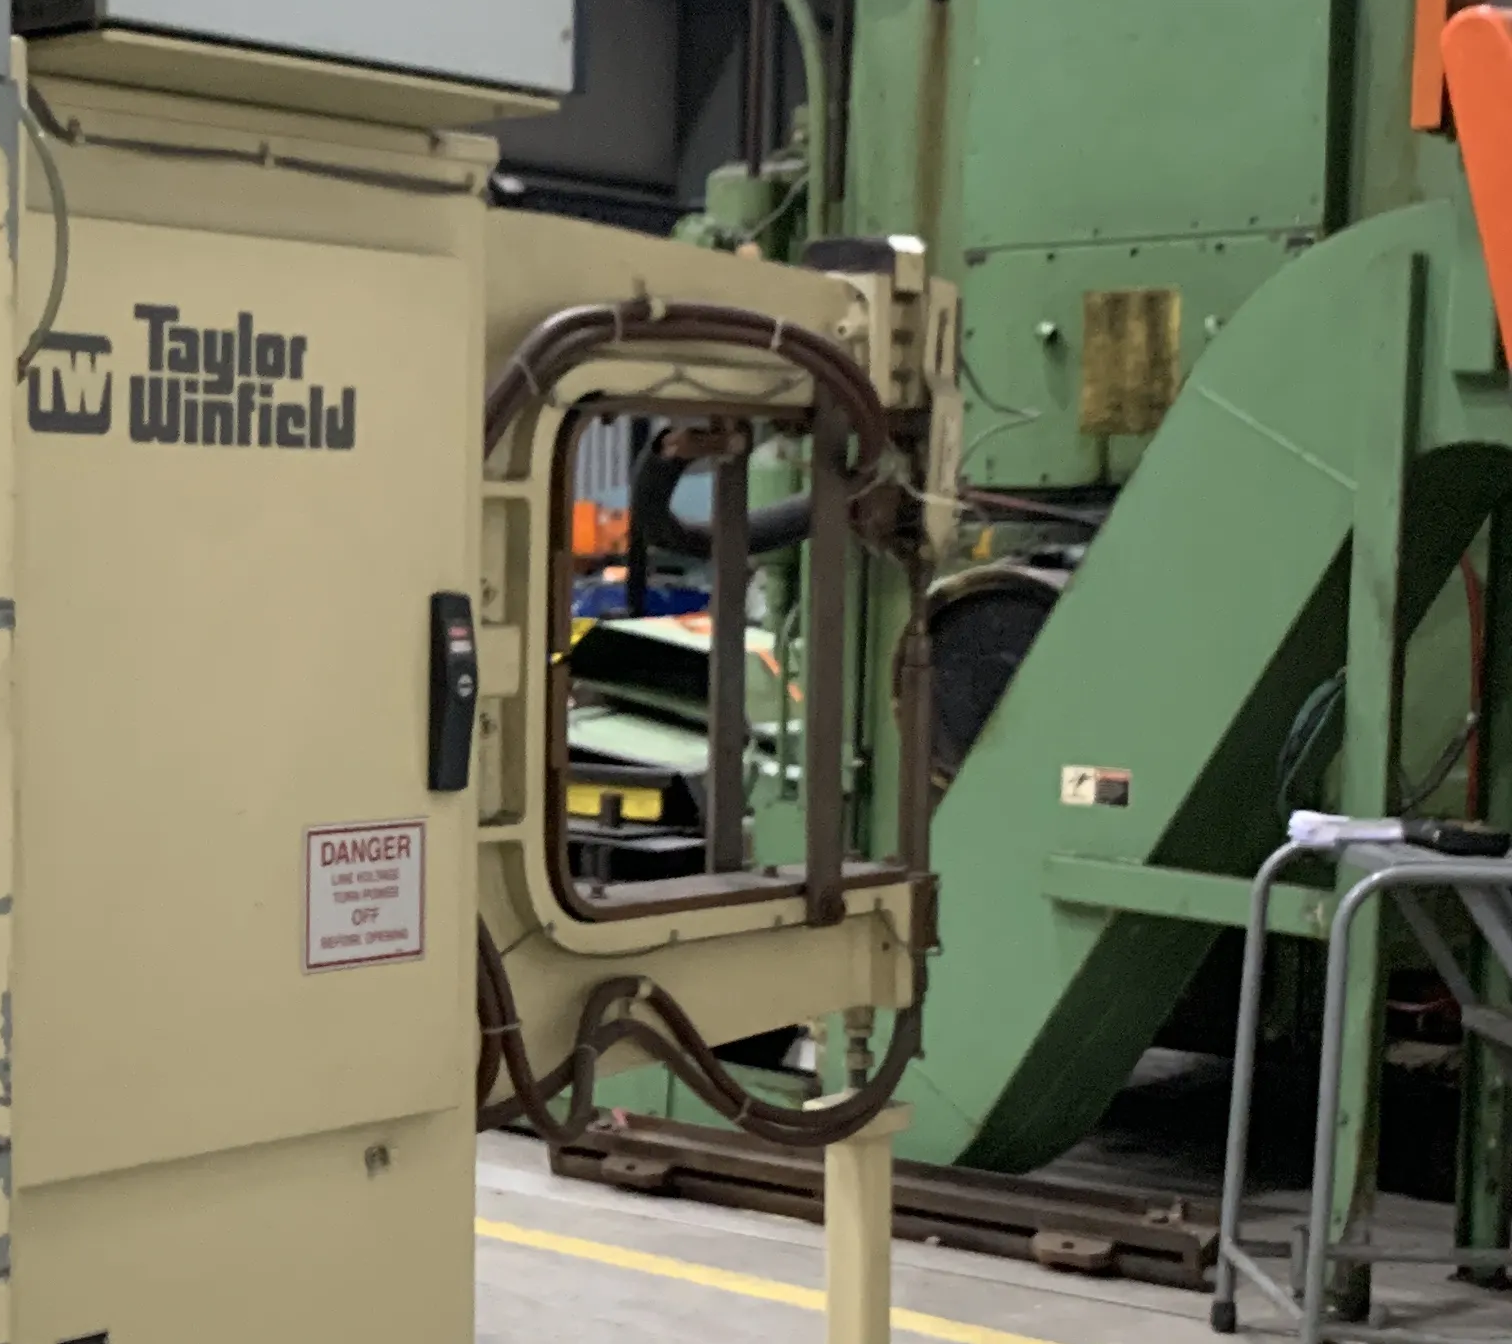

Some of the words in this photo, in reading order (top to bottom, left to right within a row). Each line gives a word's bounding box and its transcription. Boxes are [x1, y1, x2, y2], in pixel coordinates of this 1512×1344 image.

[133, 302, 308, 393] Taylor
[129, 374, 357, 450] Winfield
[320, 834, 412, 867] DANGER
[351, 906, 380, 926] OFF
